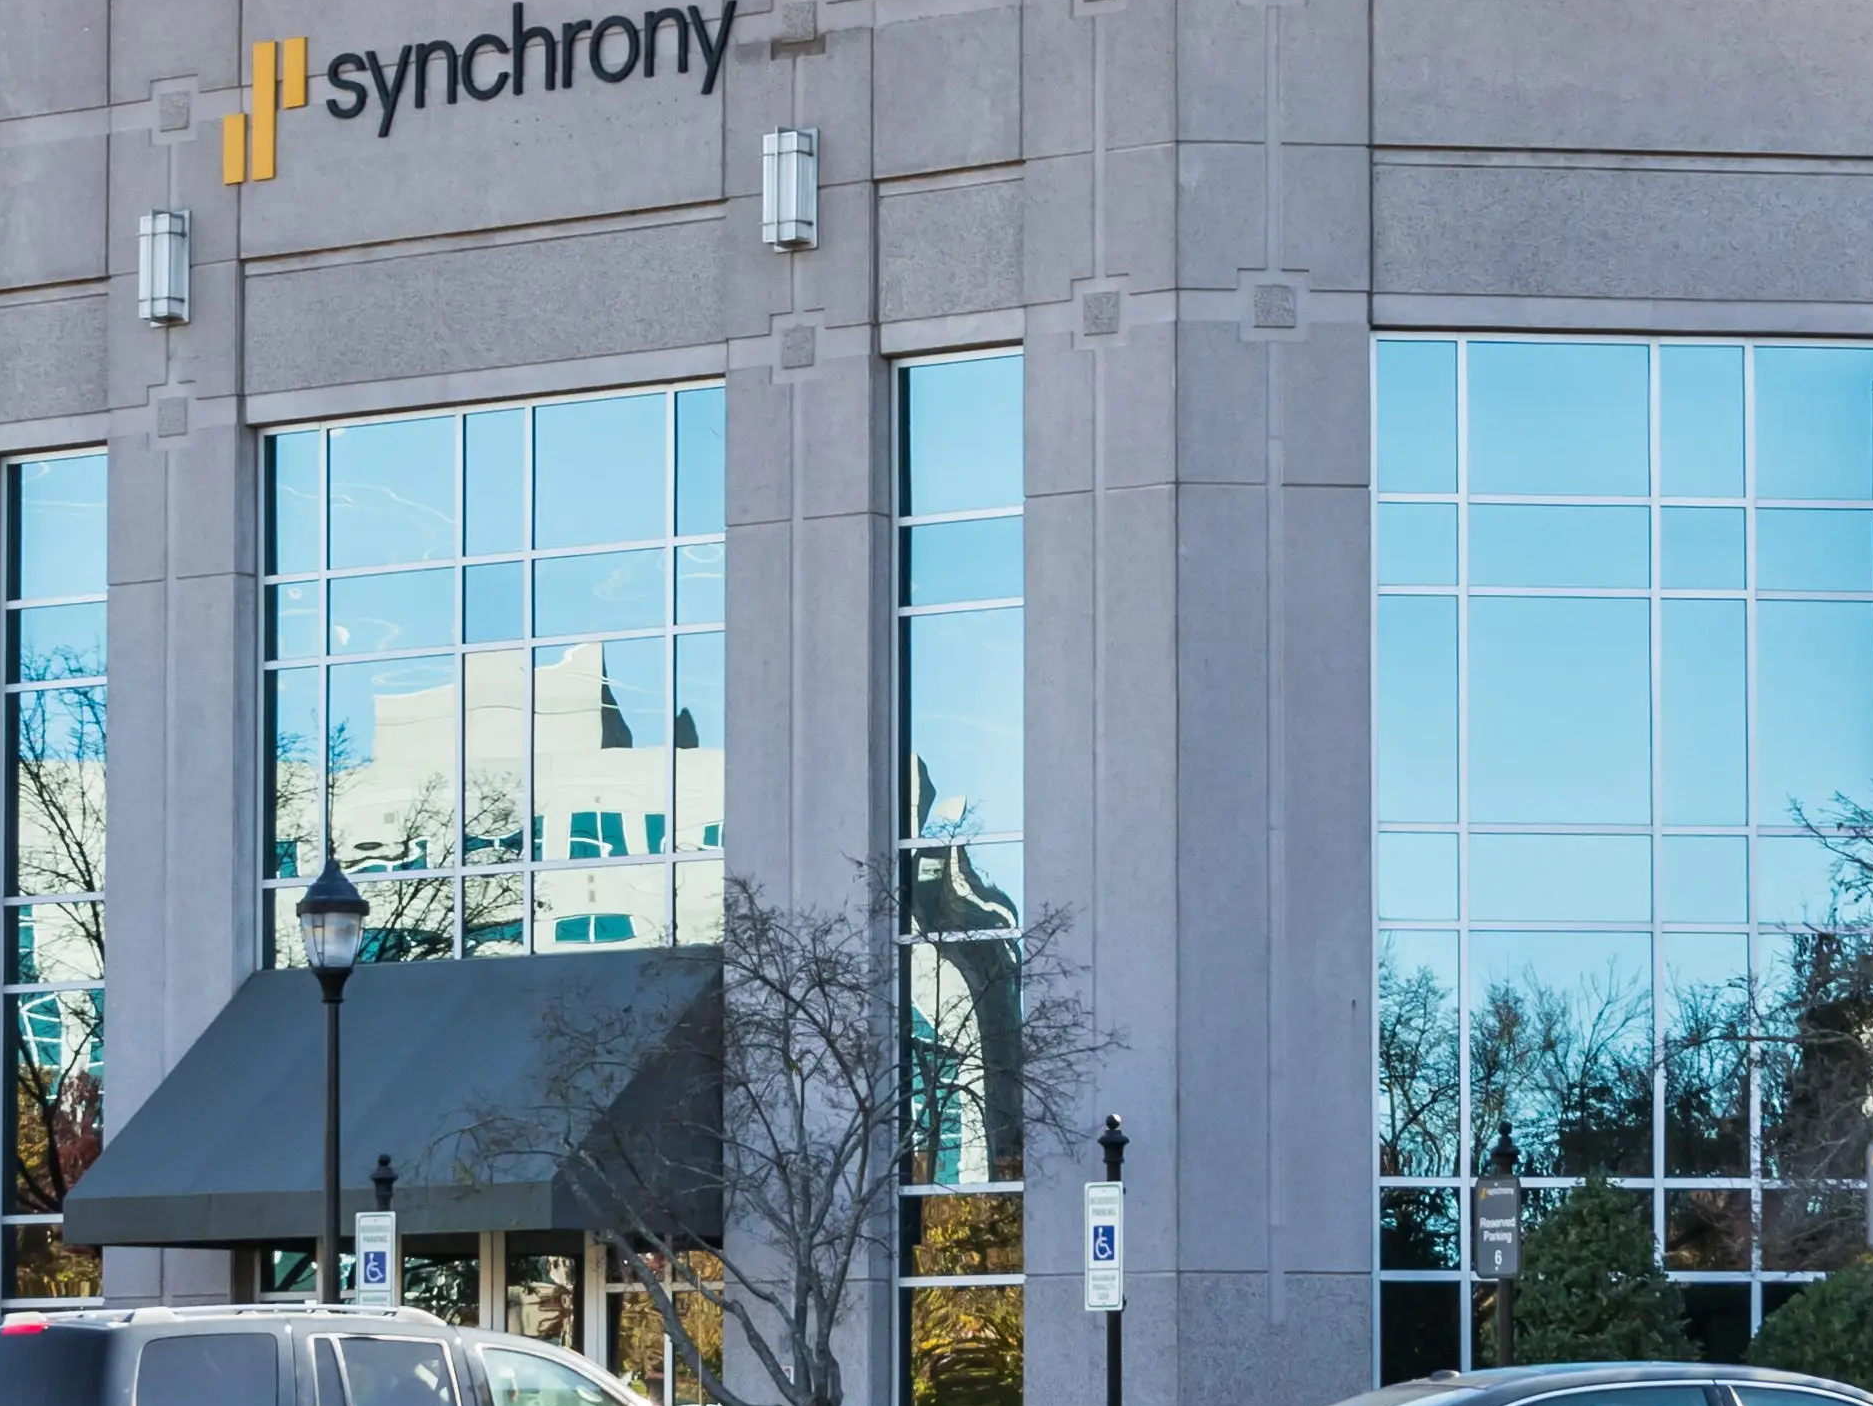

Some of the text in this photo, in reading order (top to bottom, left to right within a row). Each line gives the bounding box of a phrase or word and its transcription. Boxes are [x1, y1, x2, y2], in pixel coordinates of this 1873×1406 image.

[326, 0, 737, 137] synchrony
[1479, 1216, 1516, 1228] Reserved
[1483, 1230, 1512, 1243] Parking
[1494, 1249, 1502, 1265] 6
